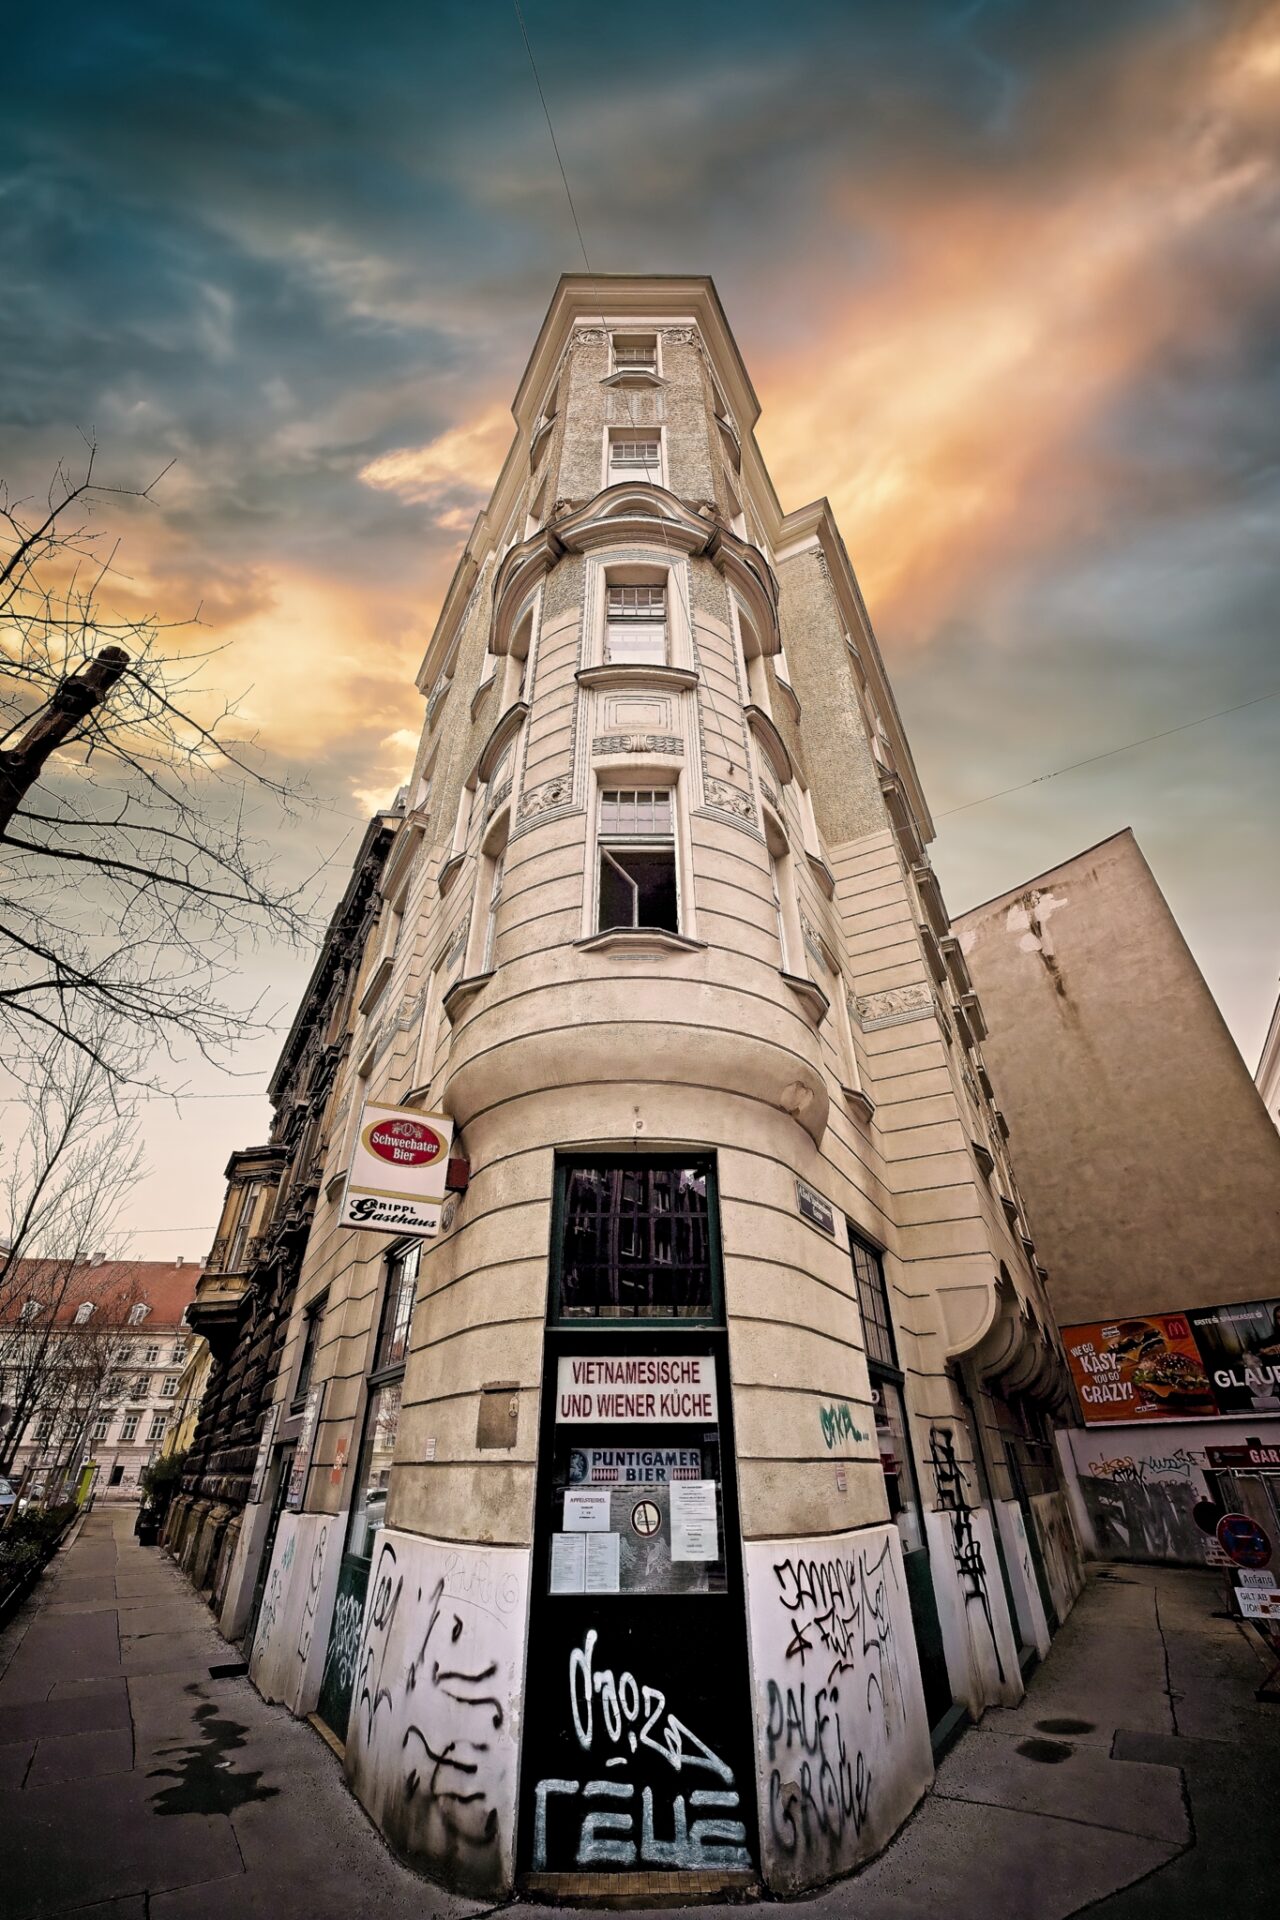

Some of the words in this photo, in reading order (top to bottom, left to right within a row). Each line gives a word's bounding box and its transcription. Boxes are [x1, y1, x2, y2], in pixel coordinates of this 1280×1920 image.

[372, 1131, 438, 1153] Schwechater
[393, 1147, 416, 1161] Bier
[349, 1198, 437, 1228] Gasthaus
[1070, 1346, 1082, 1357] WE
[1082, 1343, 1094, 1353] GO
[572, 1361, 701, 1385] VIETNAMESISCHE
[1092, 1374, 1108, 1383] YOU
[1108, 1371, 1120, 1380] GO
[1081, 1382, 1134, 1403] CRAZY!
[561, 1394, 593, 1418] UND
[596, 1394, 656, 1417] WIENER
[660, 1388, 713, 1417] KÜCHE
[592, 1451, 700, 1466] PUNTIGAMER
[1249, 1449, 1280, 1463] GAR
[626, 1468, 667, 1481] BIER
[1243, 1574, 1274, 1586] Anfang
